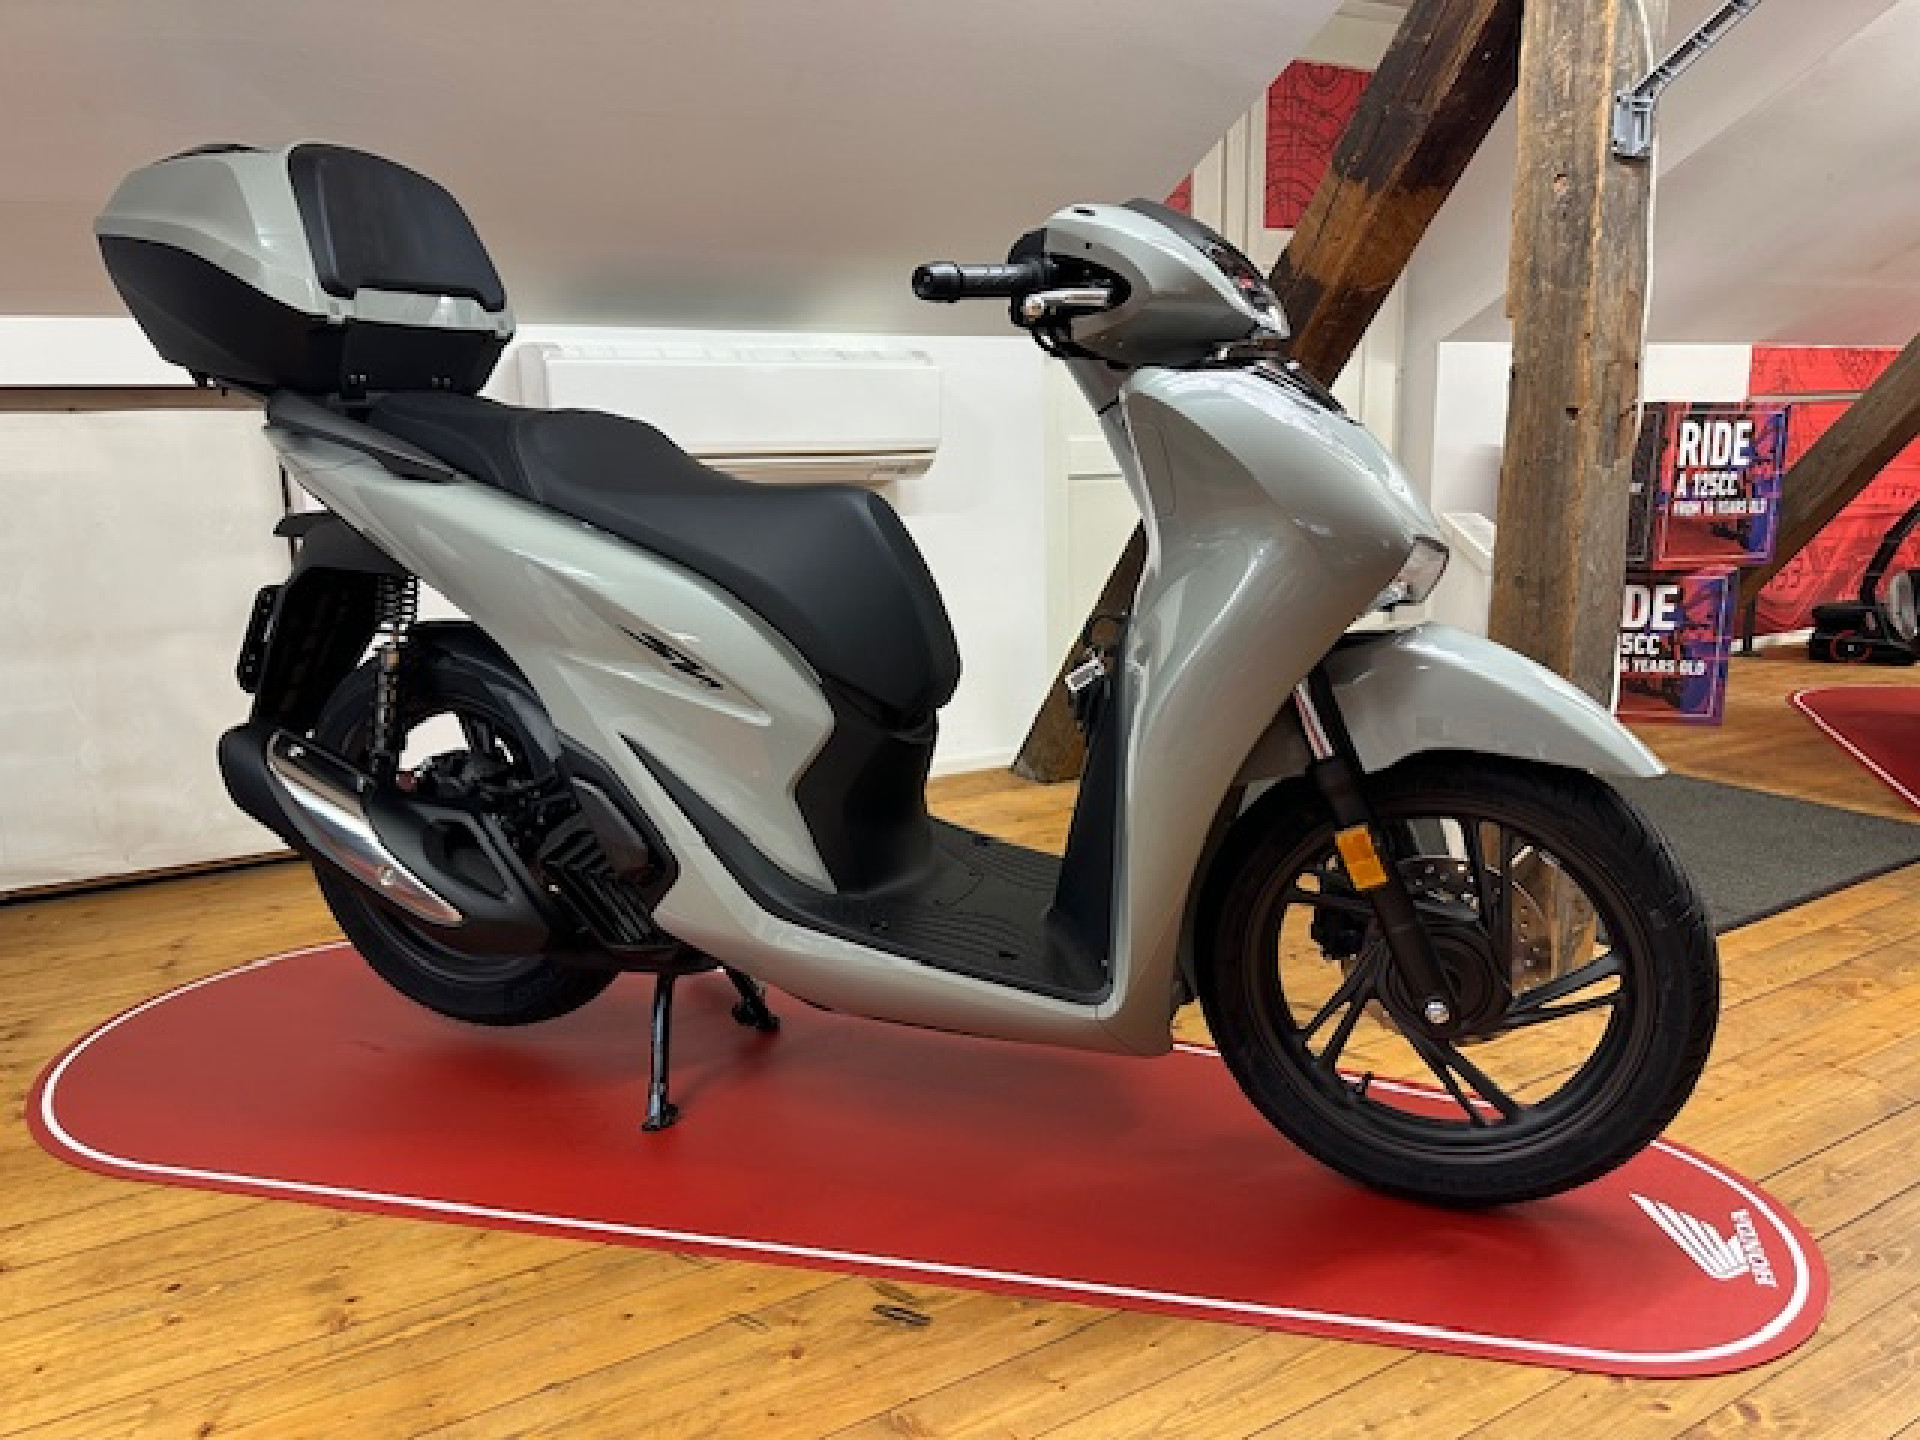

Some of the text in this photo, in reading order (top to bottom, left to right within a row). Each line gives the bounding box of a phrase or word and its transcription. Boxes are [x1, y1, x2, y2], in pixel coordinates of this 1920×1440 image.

[1678, 420, 1752, 467] RIDE
[1676, 471, 1687, 498] A
[1620, 584, 1679, 630] DE
[1730, 1208, 1778, 1288] HONDA
